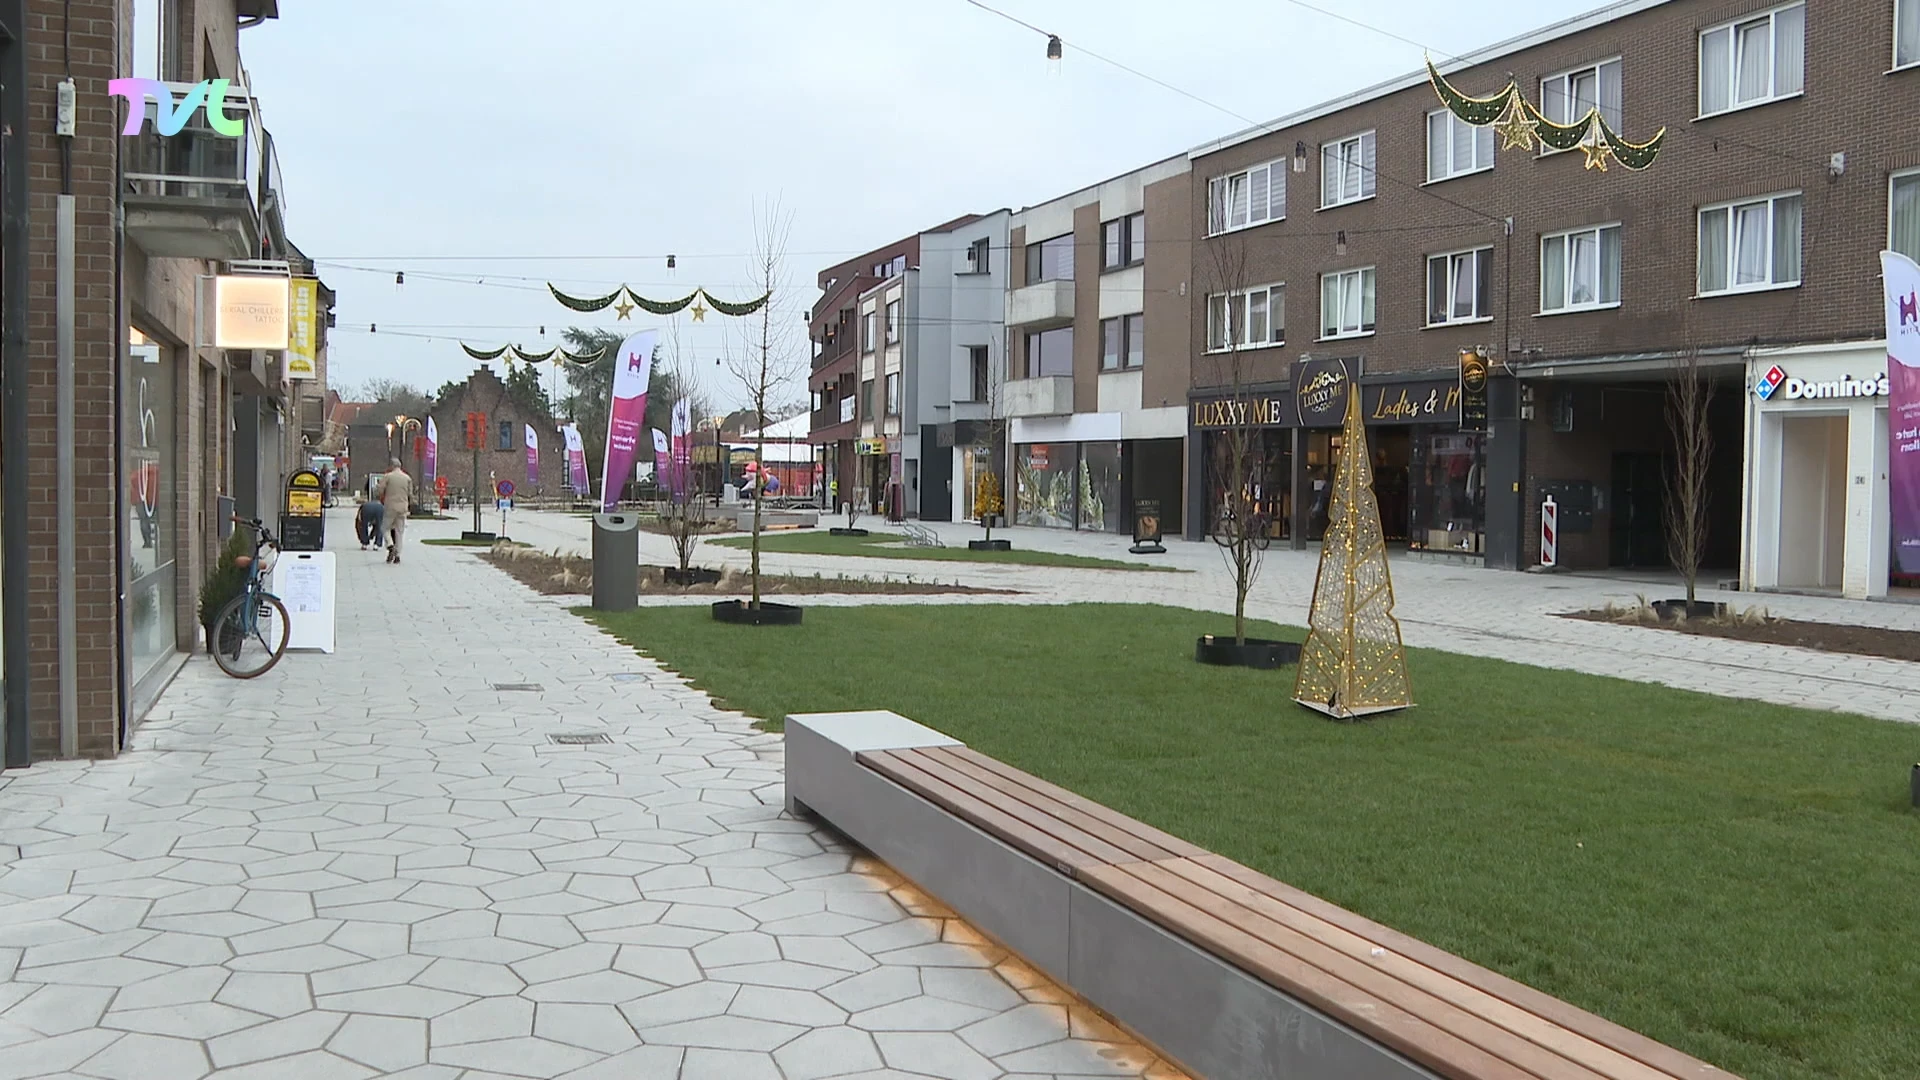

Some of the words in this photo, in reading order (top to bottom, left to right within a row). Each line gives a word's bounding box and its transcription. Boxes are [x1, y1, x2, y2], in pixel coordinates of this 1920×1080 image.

[220, 306, 246, 314] SERIAL
[254, 315, 284, 324] TATTOO
[1785, 372, 1890, 400] Domino's
[1252, 398, 1281, 425] ME
[1372, 386, 1420, 421] Ladies
[1424, 388, 1439, 415] &
